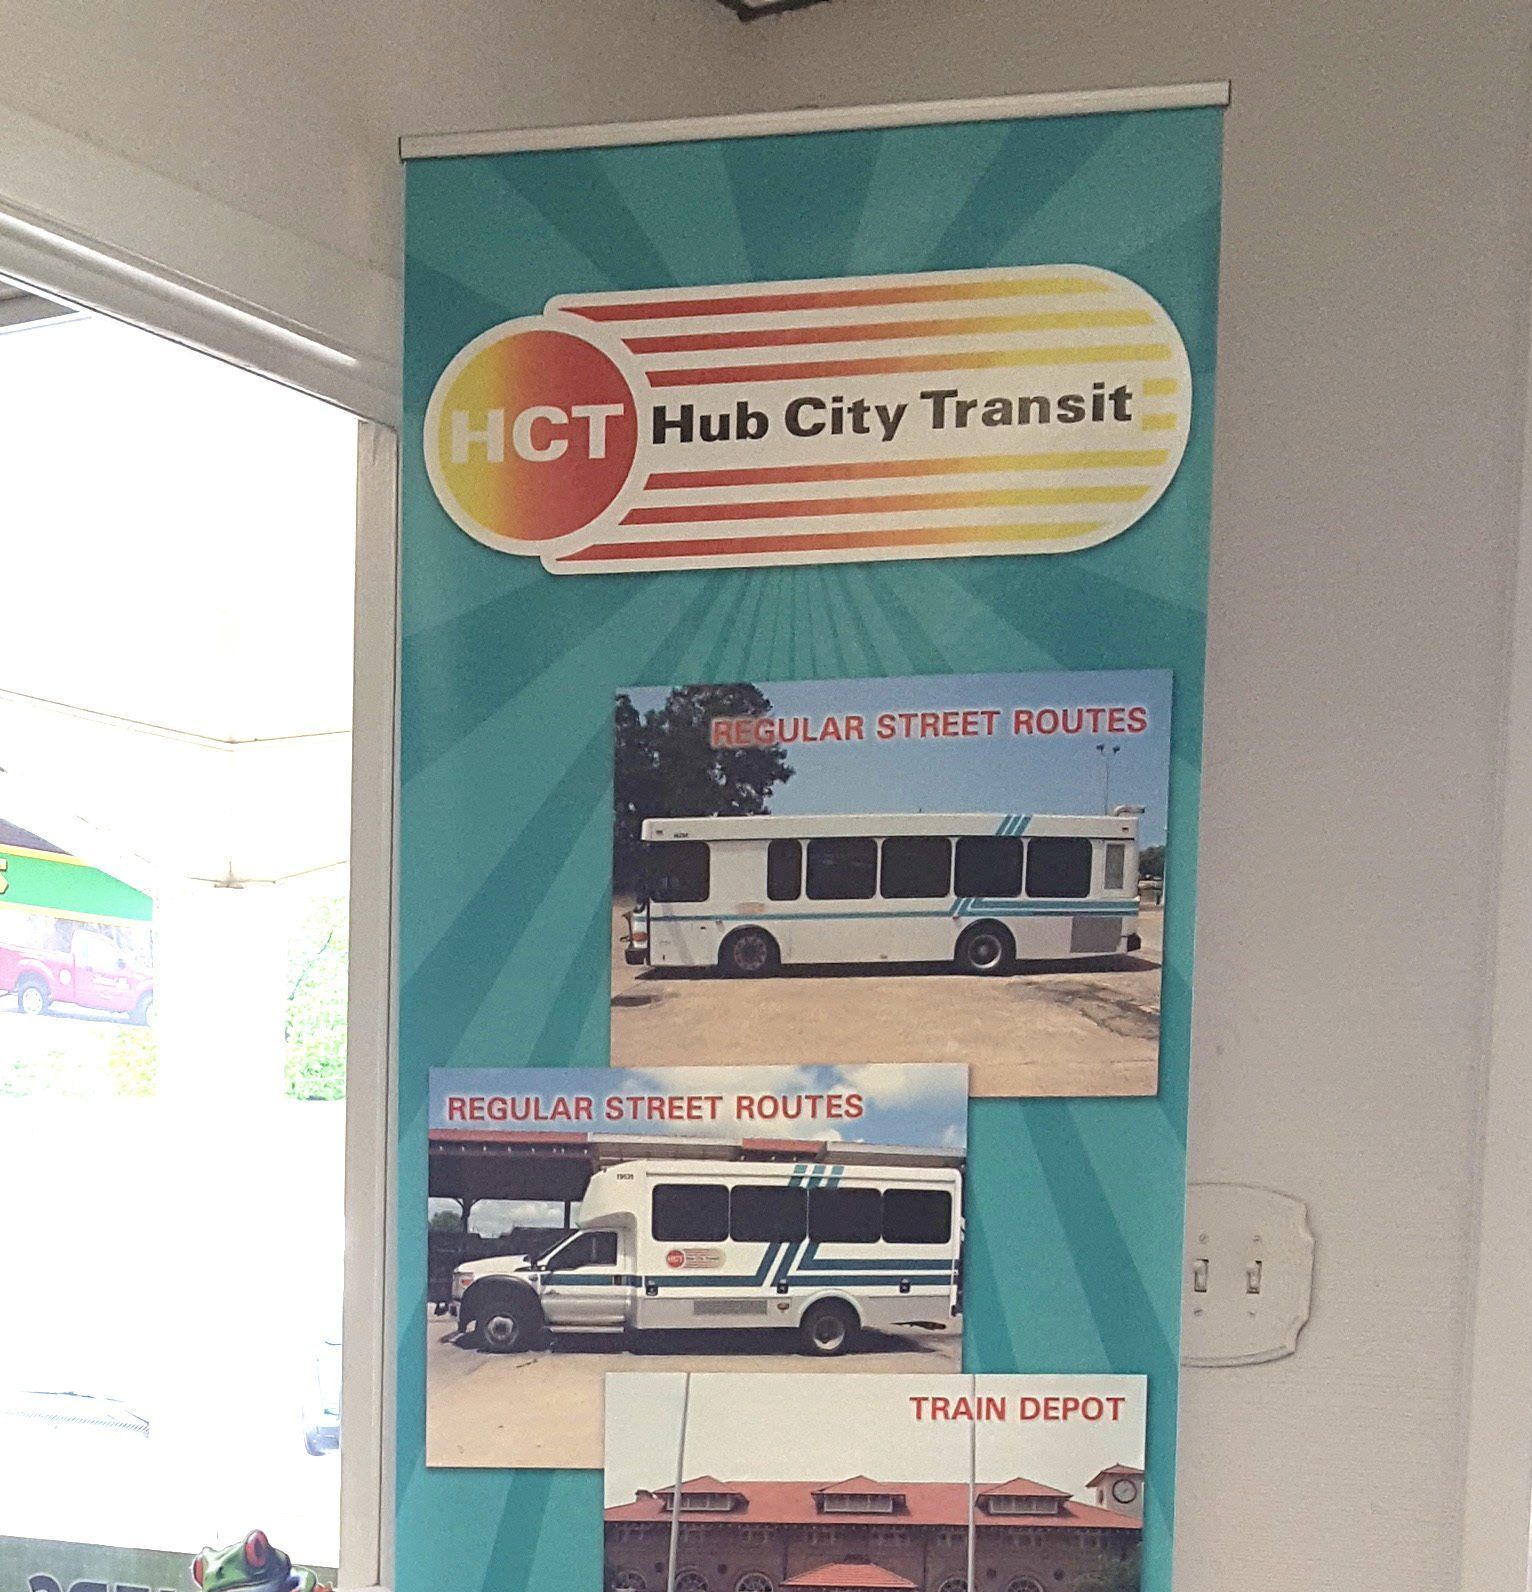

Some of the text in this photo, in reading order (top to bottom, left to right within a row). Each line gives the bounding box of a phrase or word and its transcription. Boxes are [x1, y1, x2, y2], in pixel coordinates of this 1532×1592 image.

[653, 382, 1133, 444] Hub City Transit
[448, 403, 625, 464] HCT
[712, 707, 1148, 745] REGULAR STREET ROUTES
[449, 1094, 863, 1121] REGULAR STREET ROUTES
[909, 1396, 1125, 1422] TRAIN DEPOT
